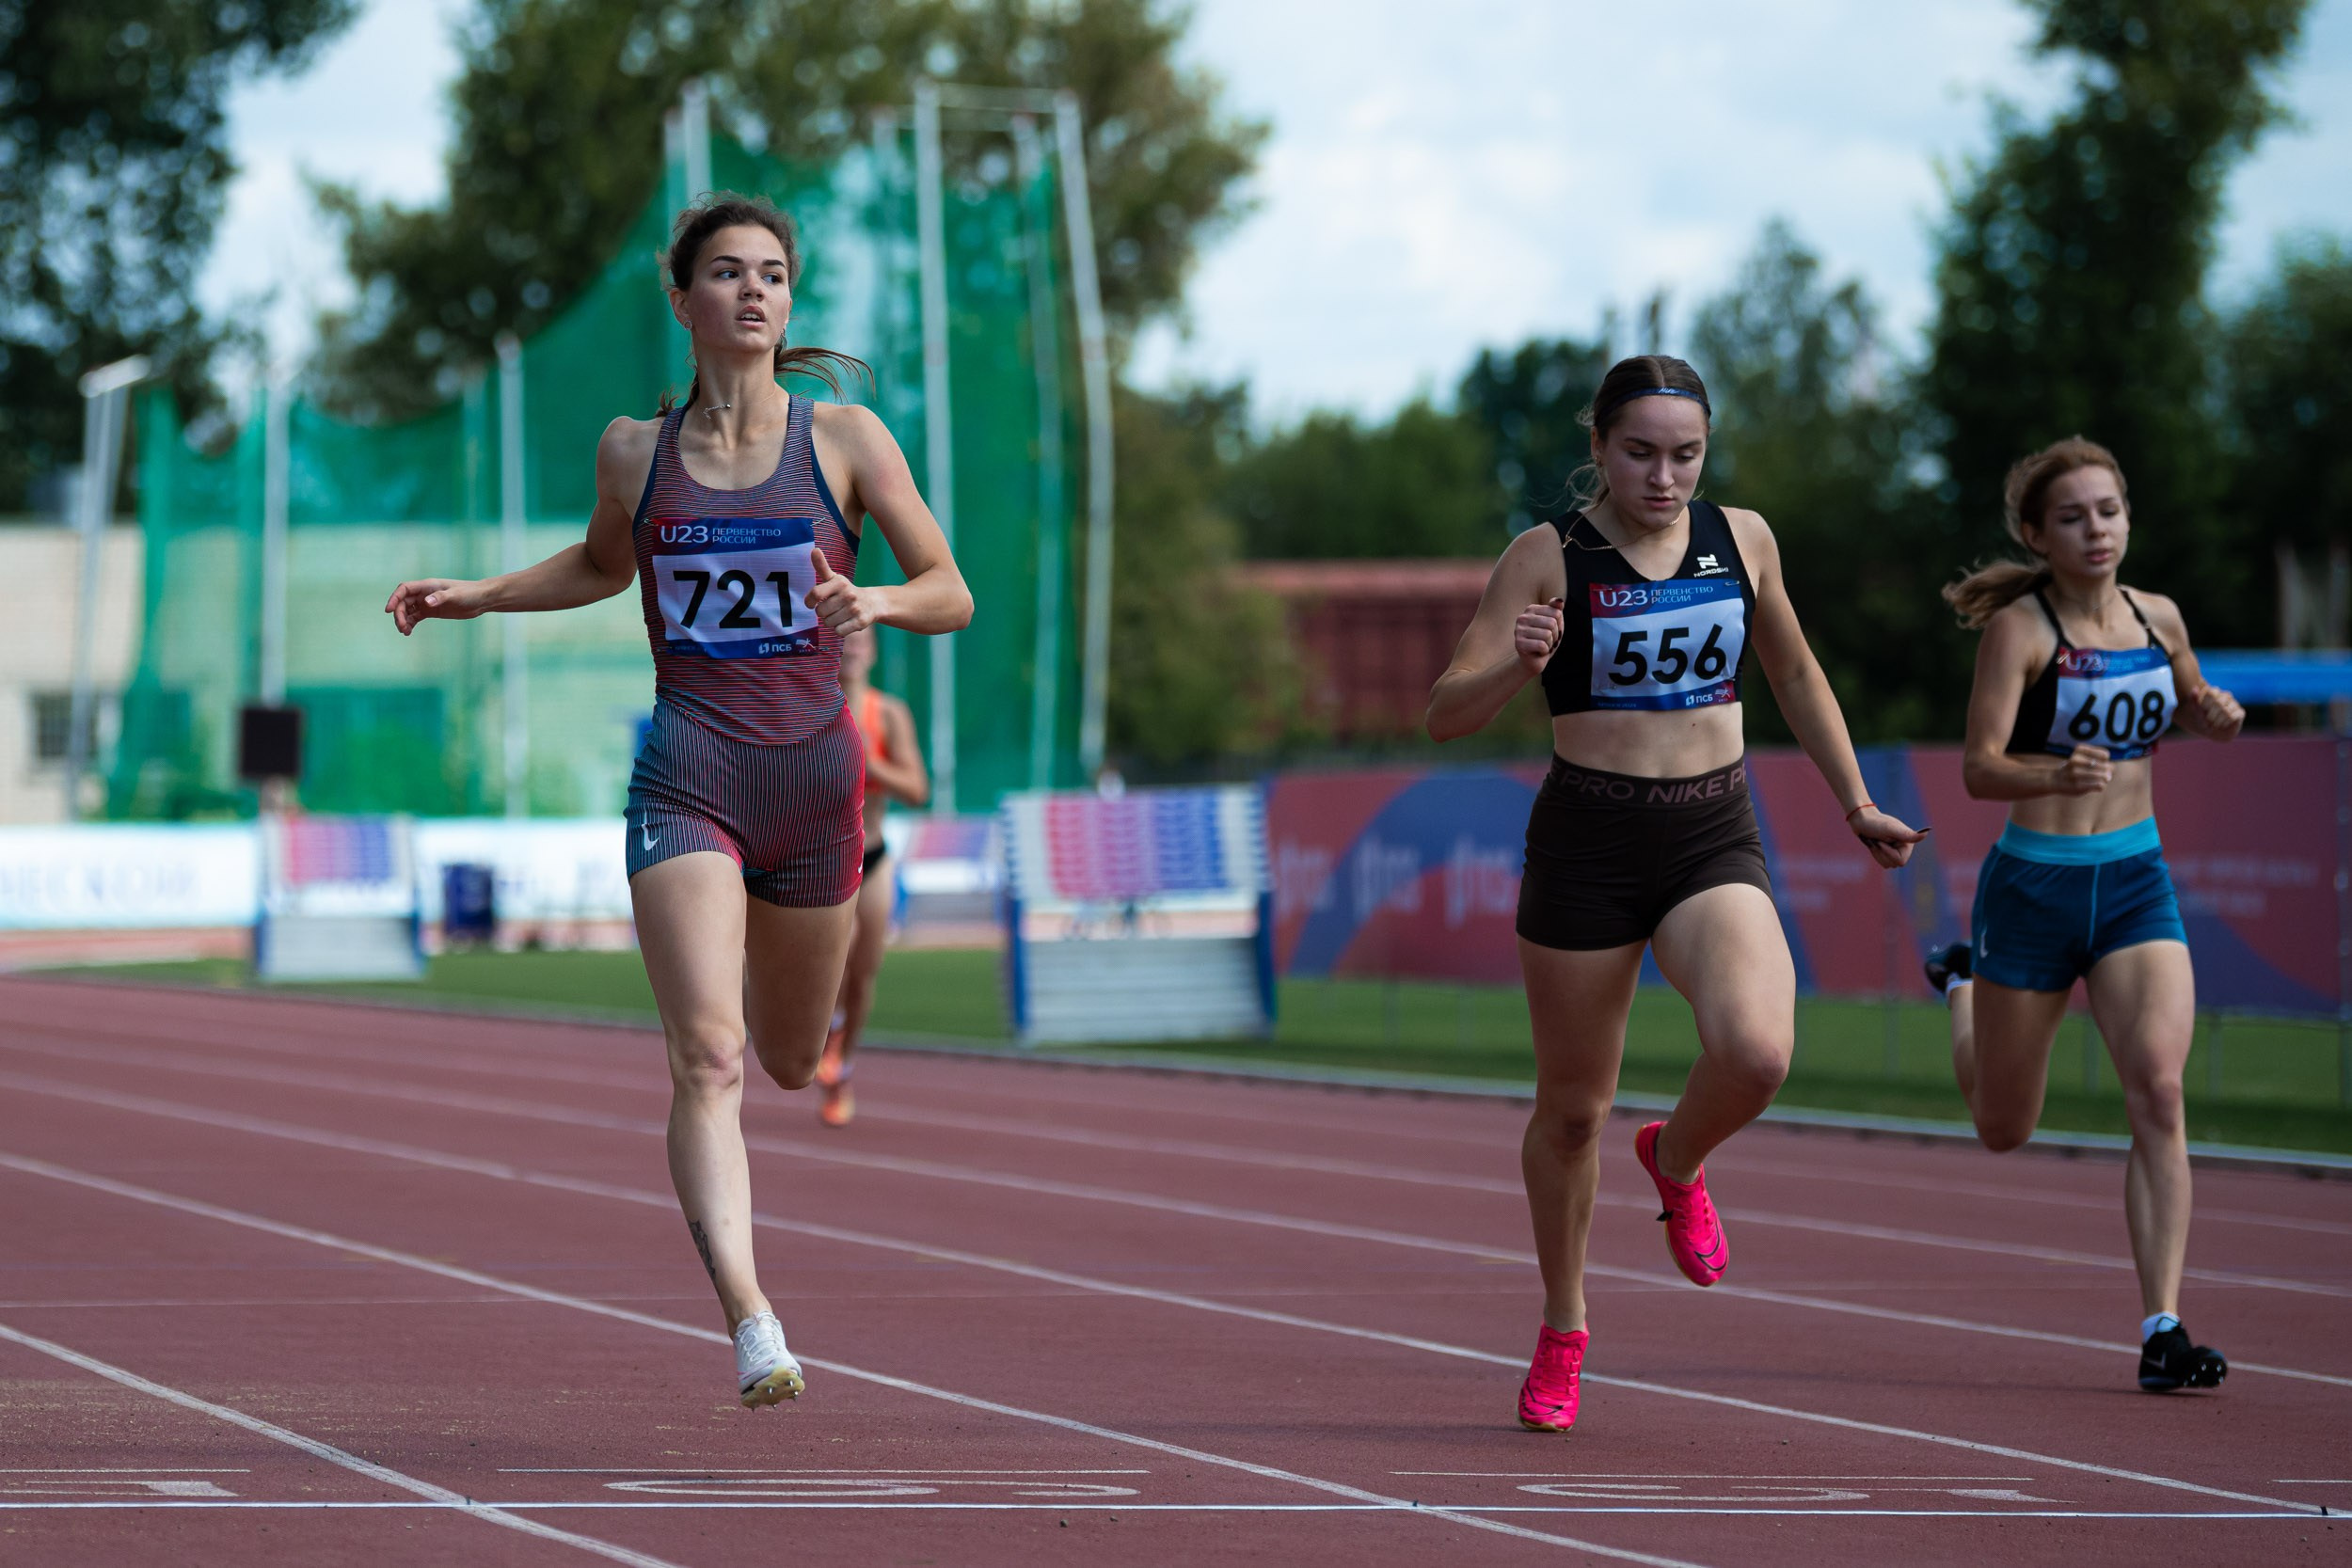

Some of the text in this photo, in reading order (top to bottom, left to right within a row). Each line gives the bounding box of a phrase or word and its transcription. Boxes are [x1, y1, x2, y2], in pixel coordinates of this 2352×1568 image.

[660, 525, 708, 544] U23
[712, 528, 781, 536] ПЕРВЕНСТВО
[712, 535, 756, 544] РОССИИ
[1651, 585, 1713, 596] ПЕРВЕНСТВО
[673, 569, 793, 629] 721
[1599, 589, 1648, 608] U23
[1651, 594, 1692, 605] РОССИИ
[771, 643, 792, 653] ПСБ
[1608, 624, 1726, 687] 556
[1695, 695, 1713, 705] ПСБ
[2070, 691, 2165, 741] 608
[1559, 770, 1636, 800] PRO
[1646, 775, 1725, 804] NIKE
